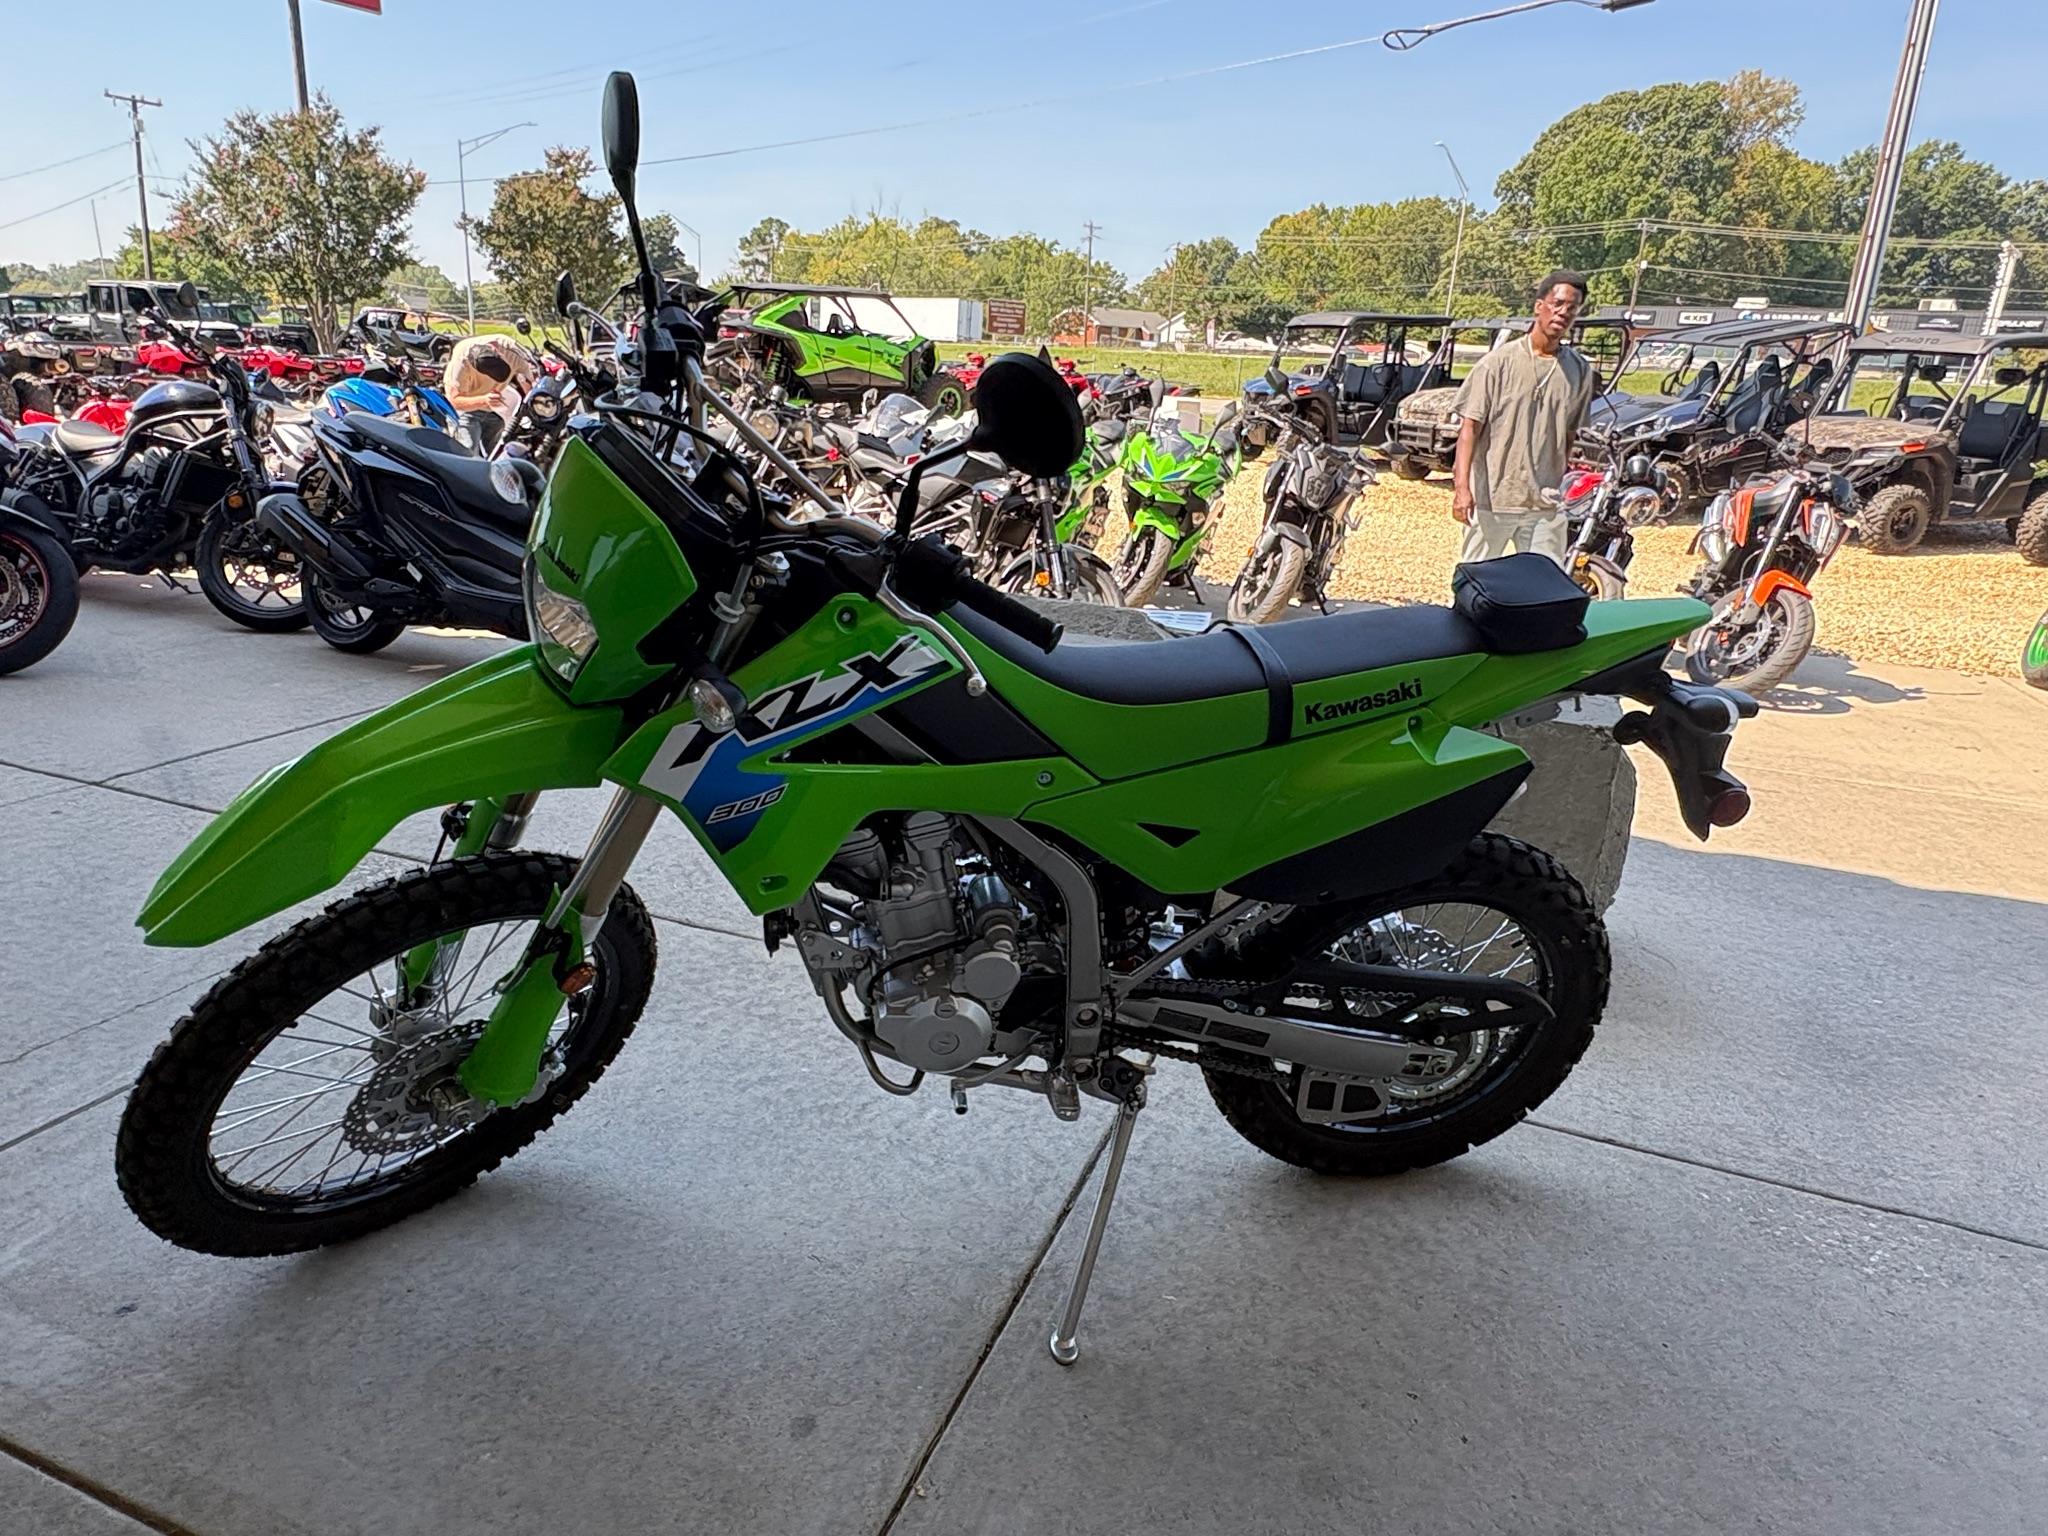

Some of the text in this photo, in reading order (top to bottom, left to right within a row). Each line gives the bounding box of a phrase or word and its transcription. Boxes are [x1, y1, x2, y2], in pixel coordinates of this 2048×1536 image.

[1891, 336, 1941, 345] CFMOTO
[1304, 677, 1423, 725] Kawasaki
[705, 783, 790, 825] 300
